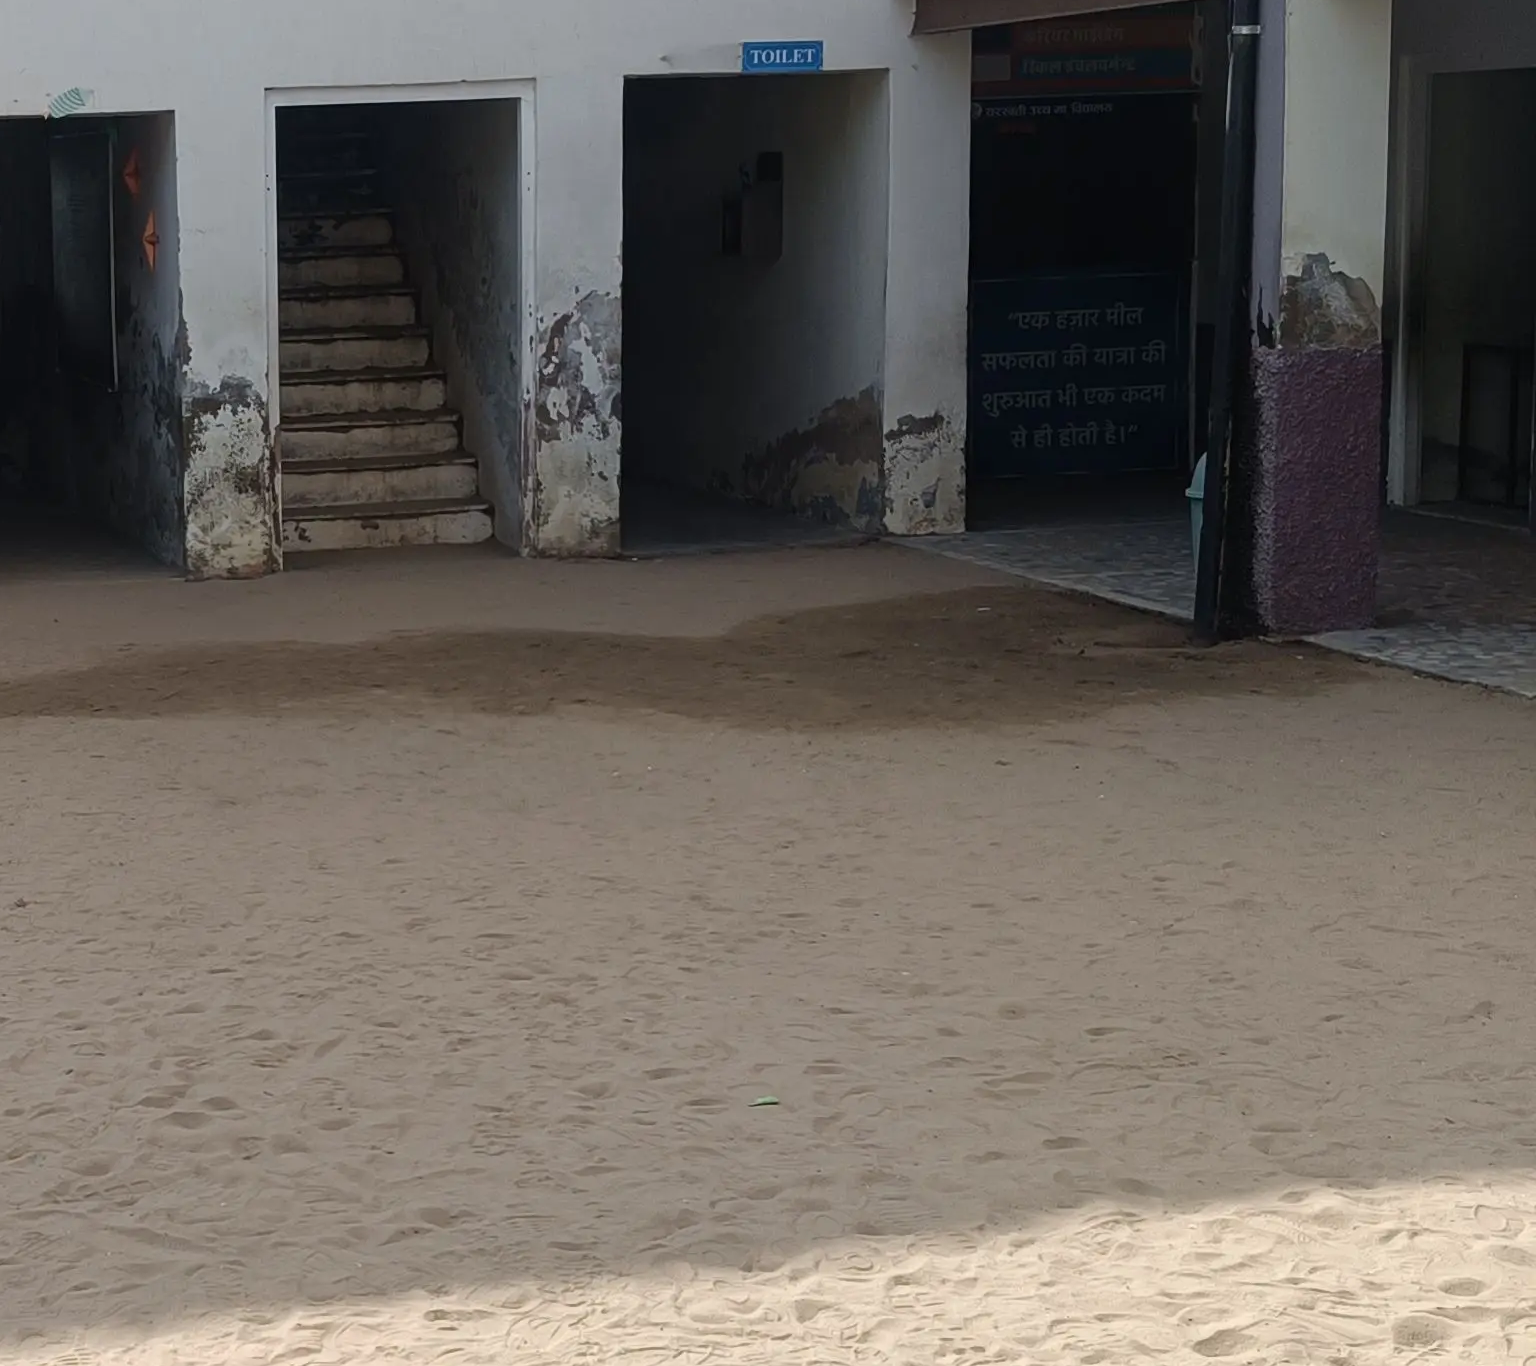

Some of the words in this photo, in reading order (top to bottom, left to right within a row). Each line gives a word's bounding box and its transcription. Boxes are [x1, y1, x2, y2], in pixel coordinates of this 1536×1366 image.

[750, 48, 816, 65] TOILET
[1054, 309, 1101, 331] हज़ार
[1105, 300, 1145, 327] मील
[981, 350, 1058, 371] सफलता
[1062, 342, 1088, 367] की
[1092, 346, 1136, 366] यात्रा
[1140, 338, 1167, 365] की
[981, 389, 1053, 418] शुरुआत
[1055, 383, 1078, 407] भी
[1082, 387, 1116, 405] एक
[1117, 383, 1166, 404] कदम
[1010, 424, 1028, 448] से
[1033, 423, 1053, 448] ही
[1057, 421, 1098, 447] होती
